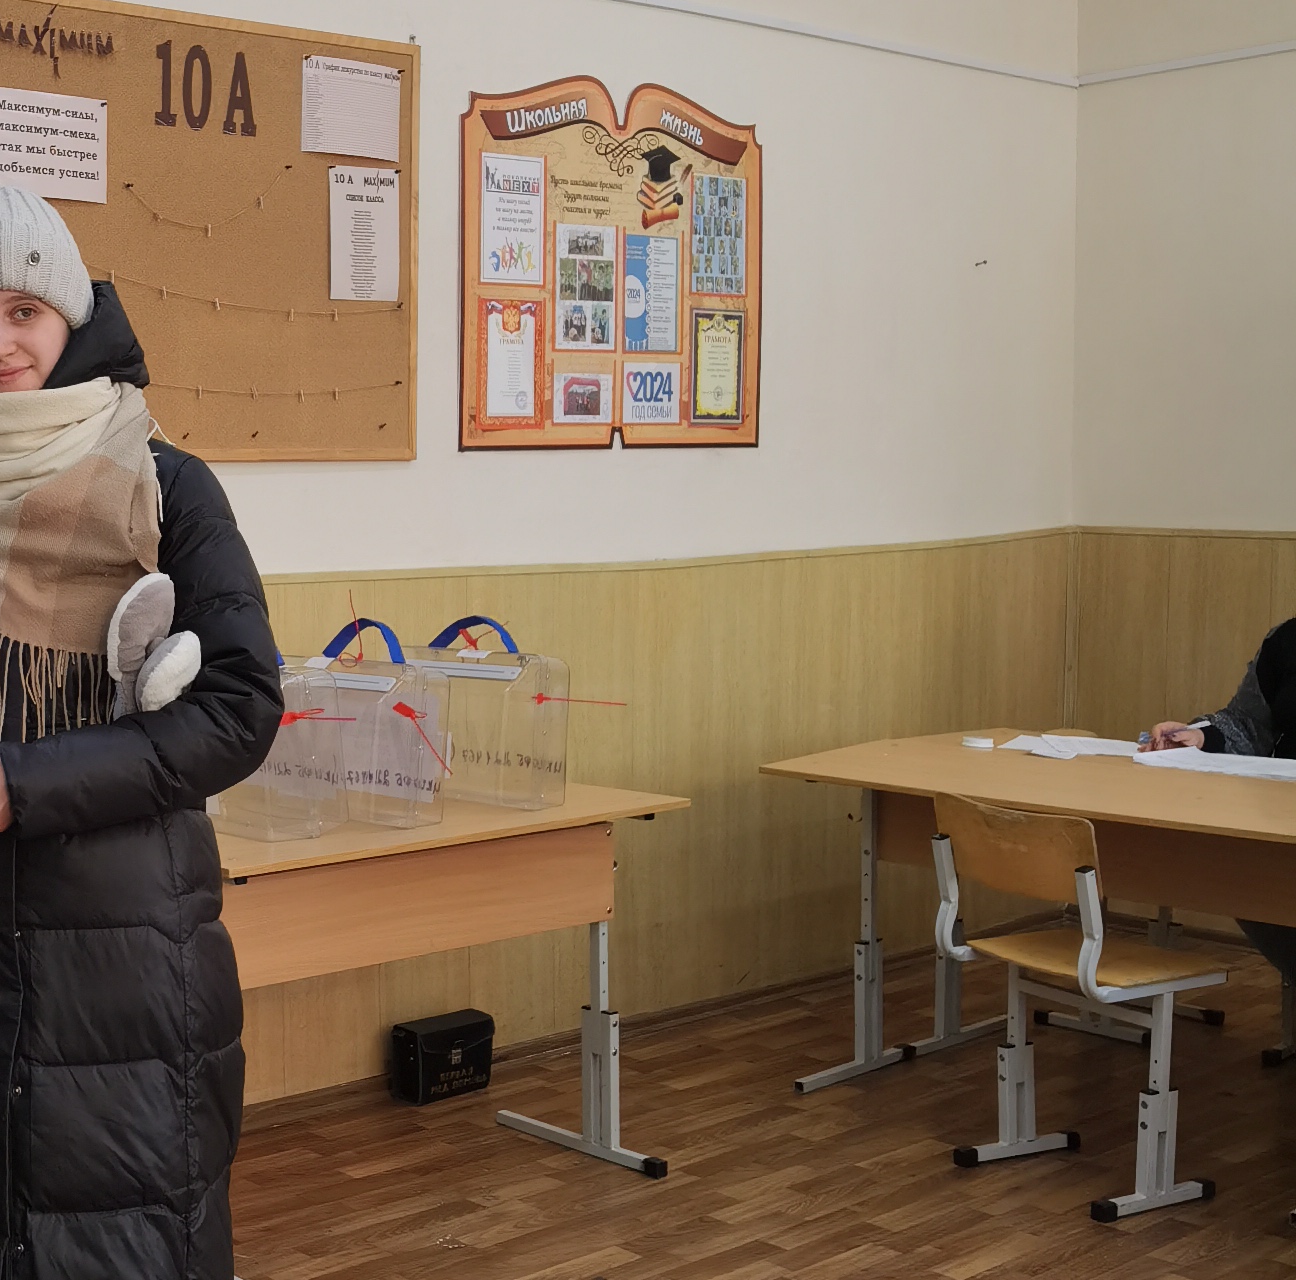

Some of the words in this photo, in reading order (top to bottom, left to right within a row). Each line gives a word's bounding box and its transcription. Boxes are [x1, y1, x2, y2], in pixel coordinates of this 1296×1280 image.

[154, 40, 212, 131] 10
[222, 51, 257, 137] А
[0, 142, 22, 154] так
[26, 145, 46, 155] мы
[49, 145, 98, 161] быстрее
[58, 168, 100, 181] успеха!
[334, 174, 345, 184] 10
[347, 175, 354, 185] А
[503, 180, 540, 194] NEXT
[633, 371, 673, 403] 2024
